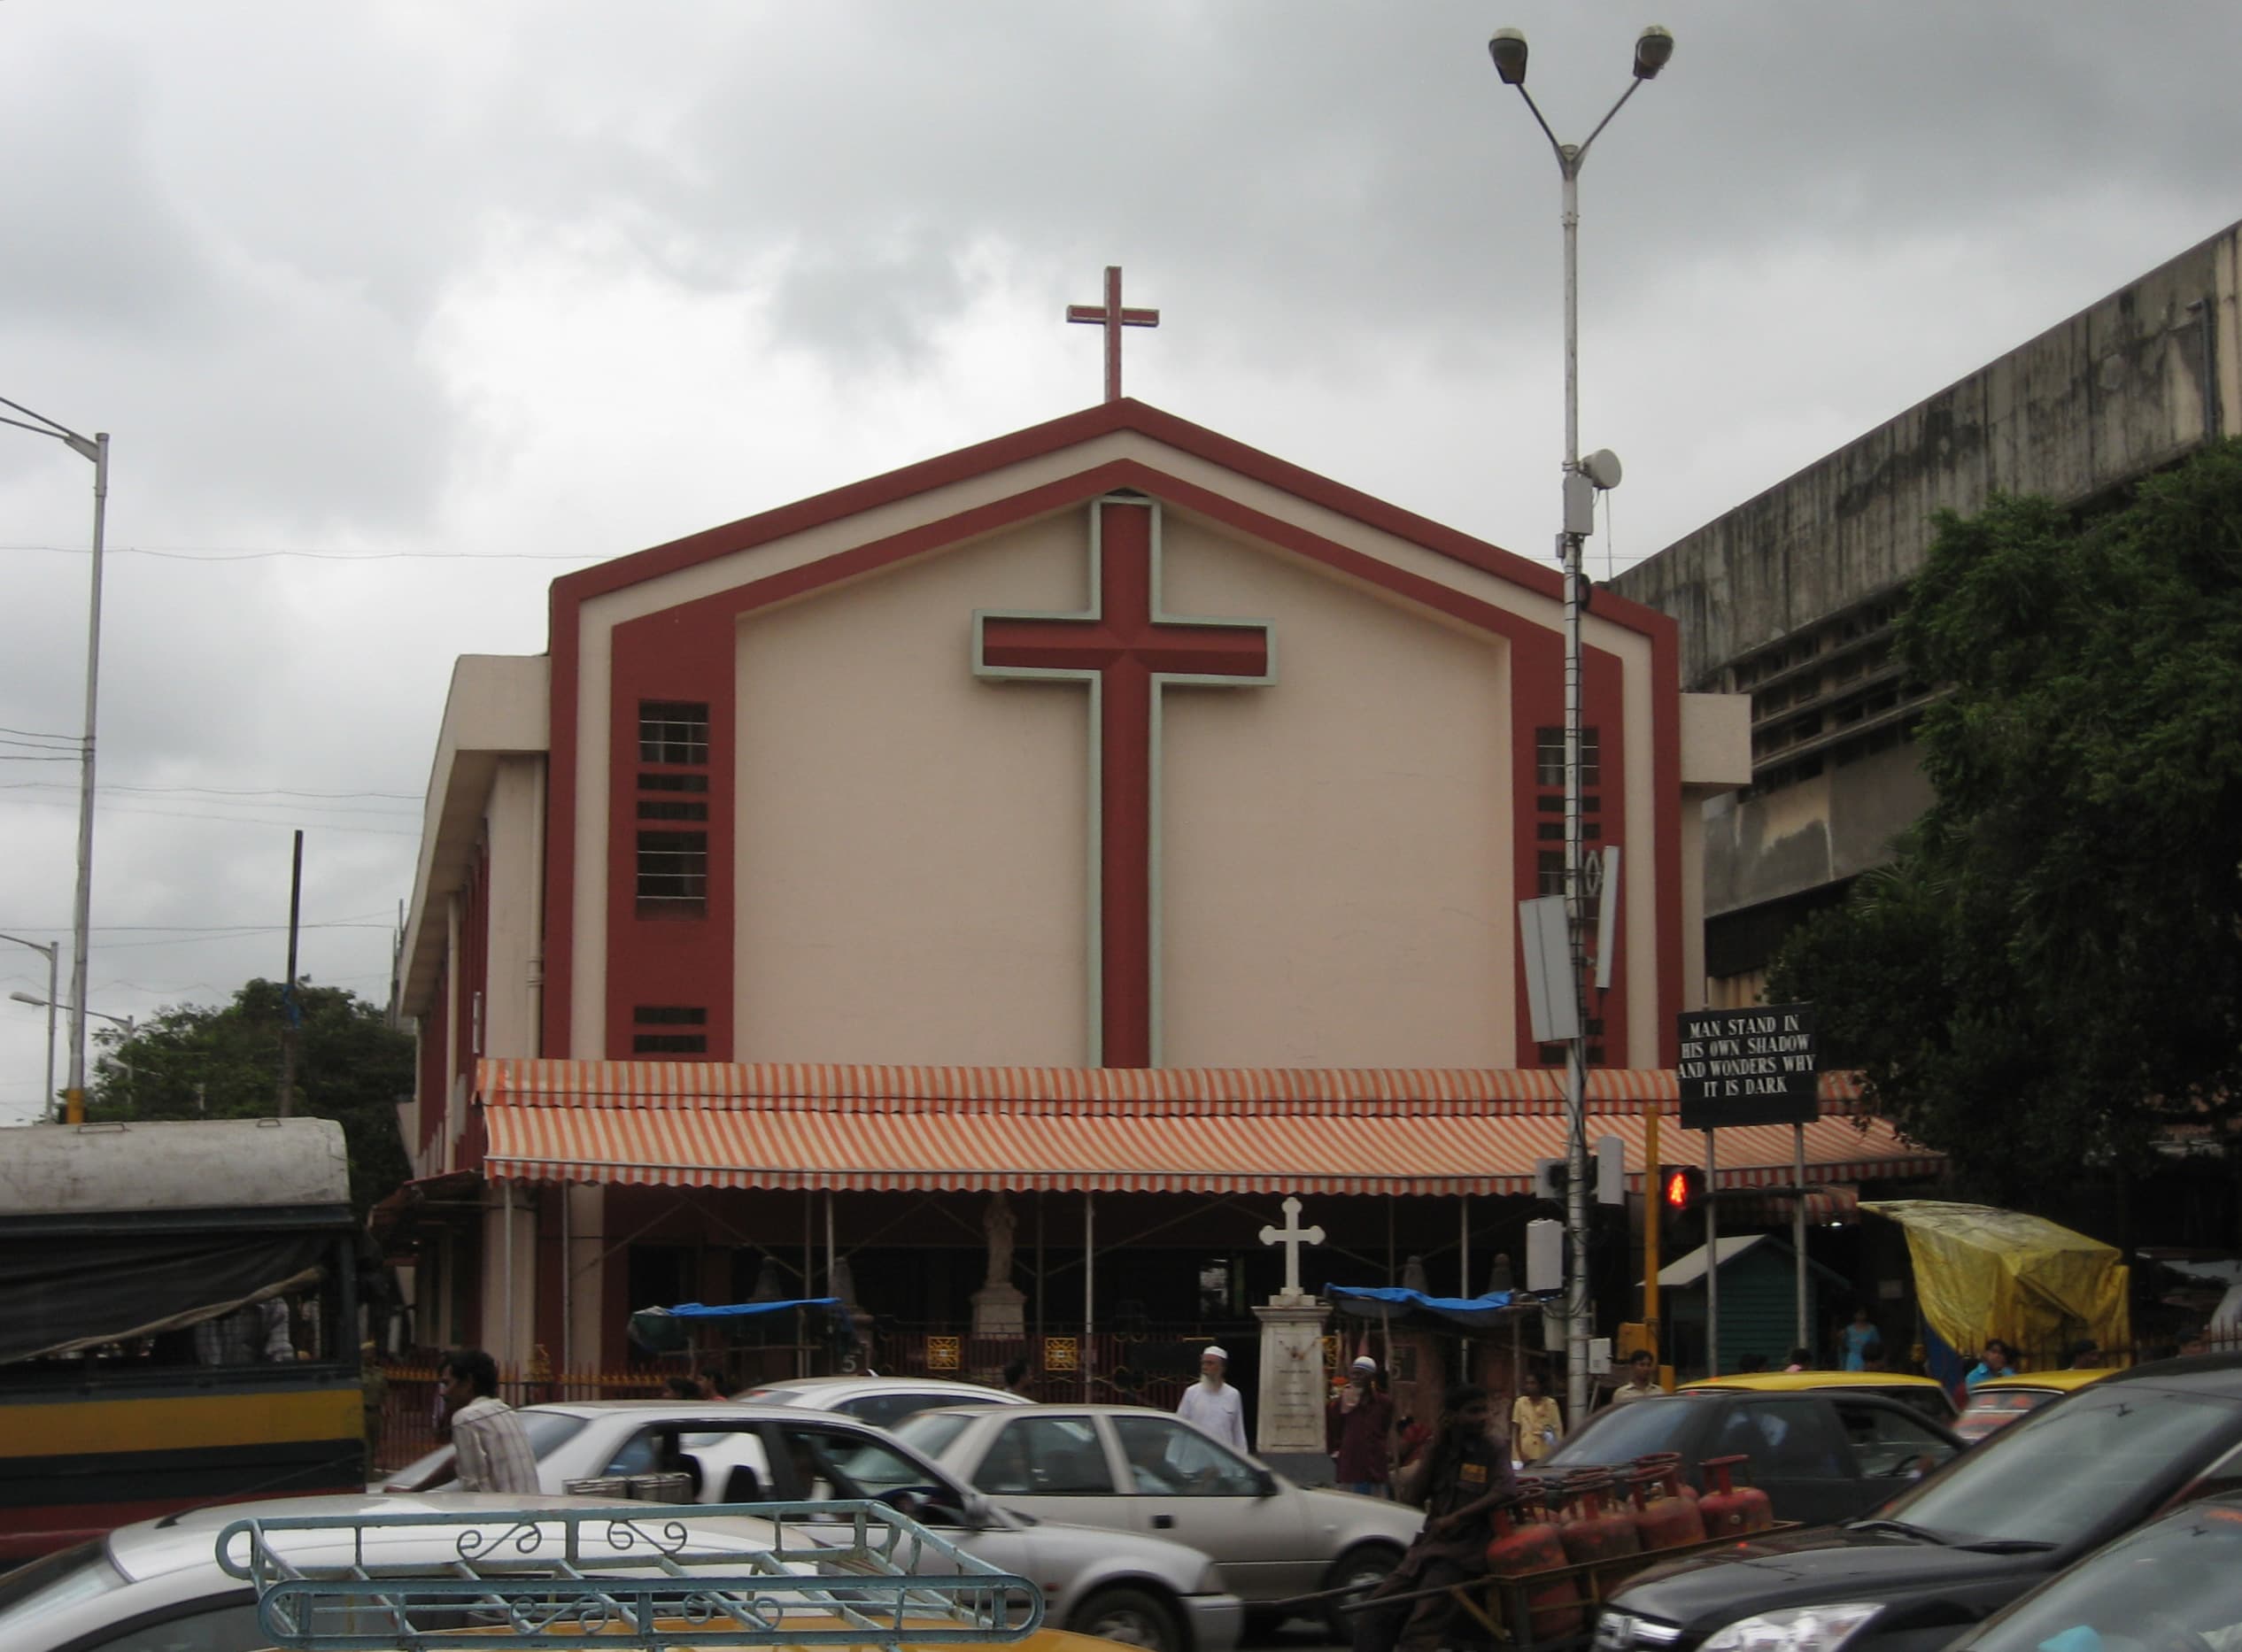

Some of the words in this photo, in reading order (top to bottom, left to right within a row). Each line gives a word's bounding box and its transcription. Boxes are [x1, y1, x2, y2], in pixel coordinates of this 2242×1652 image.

[1689, 1020, 1721, 1038] MAN
[1728, 1016, 1776, 1035] STAND
[1783, 1014, 1799, 1031] IN
[1682, 1042, 1705, 1059] HIS
[1709, 1039, 1740, 1057] OWN
[1747, 1033, 1811, 1054] SHADOW
[1679, 1061, 1706, 1078] AND
[1710, 1056, 1777, 1077] WONDERS
[1782, 1054, 1816, 1072] WHY
[1704, 1081, 1718, 1097] IT
[1725, 1079, 1739, 1096] IS
[1744, 1076, 1788, 1095] DARK
